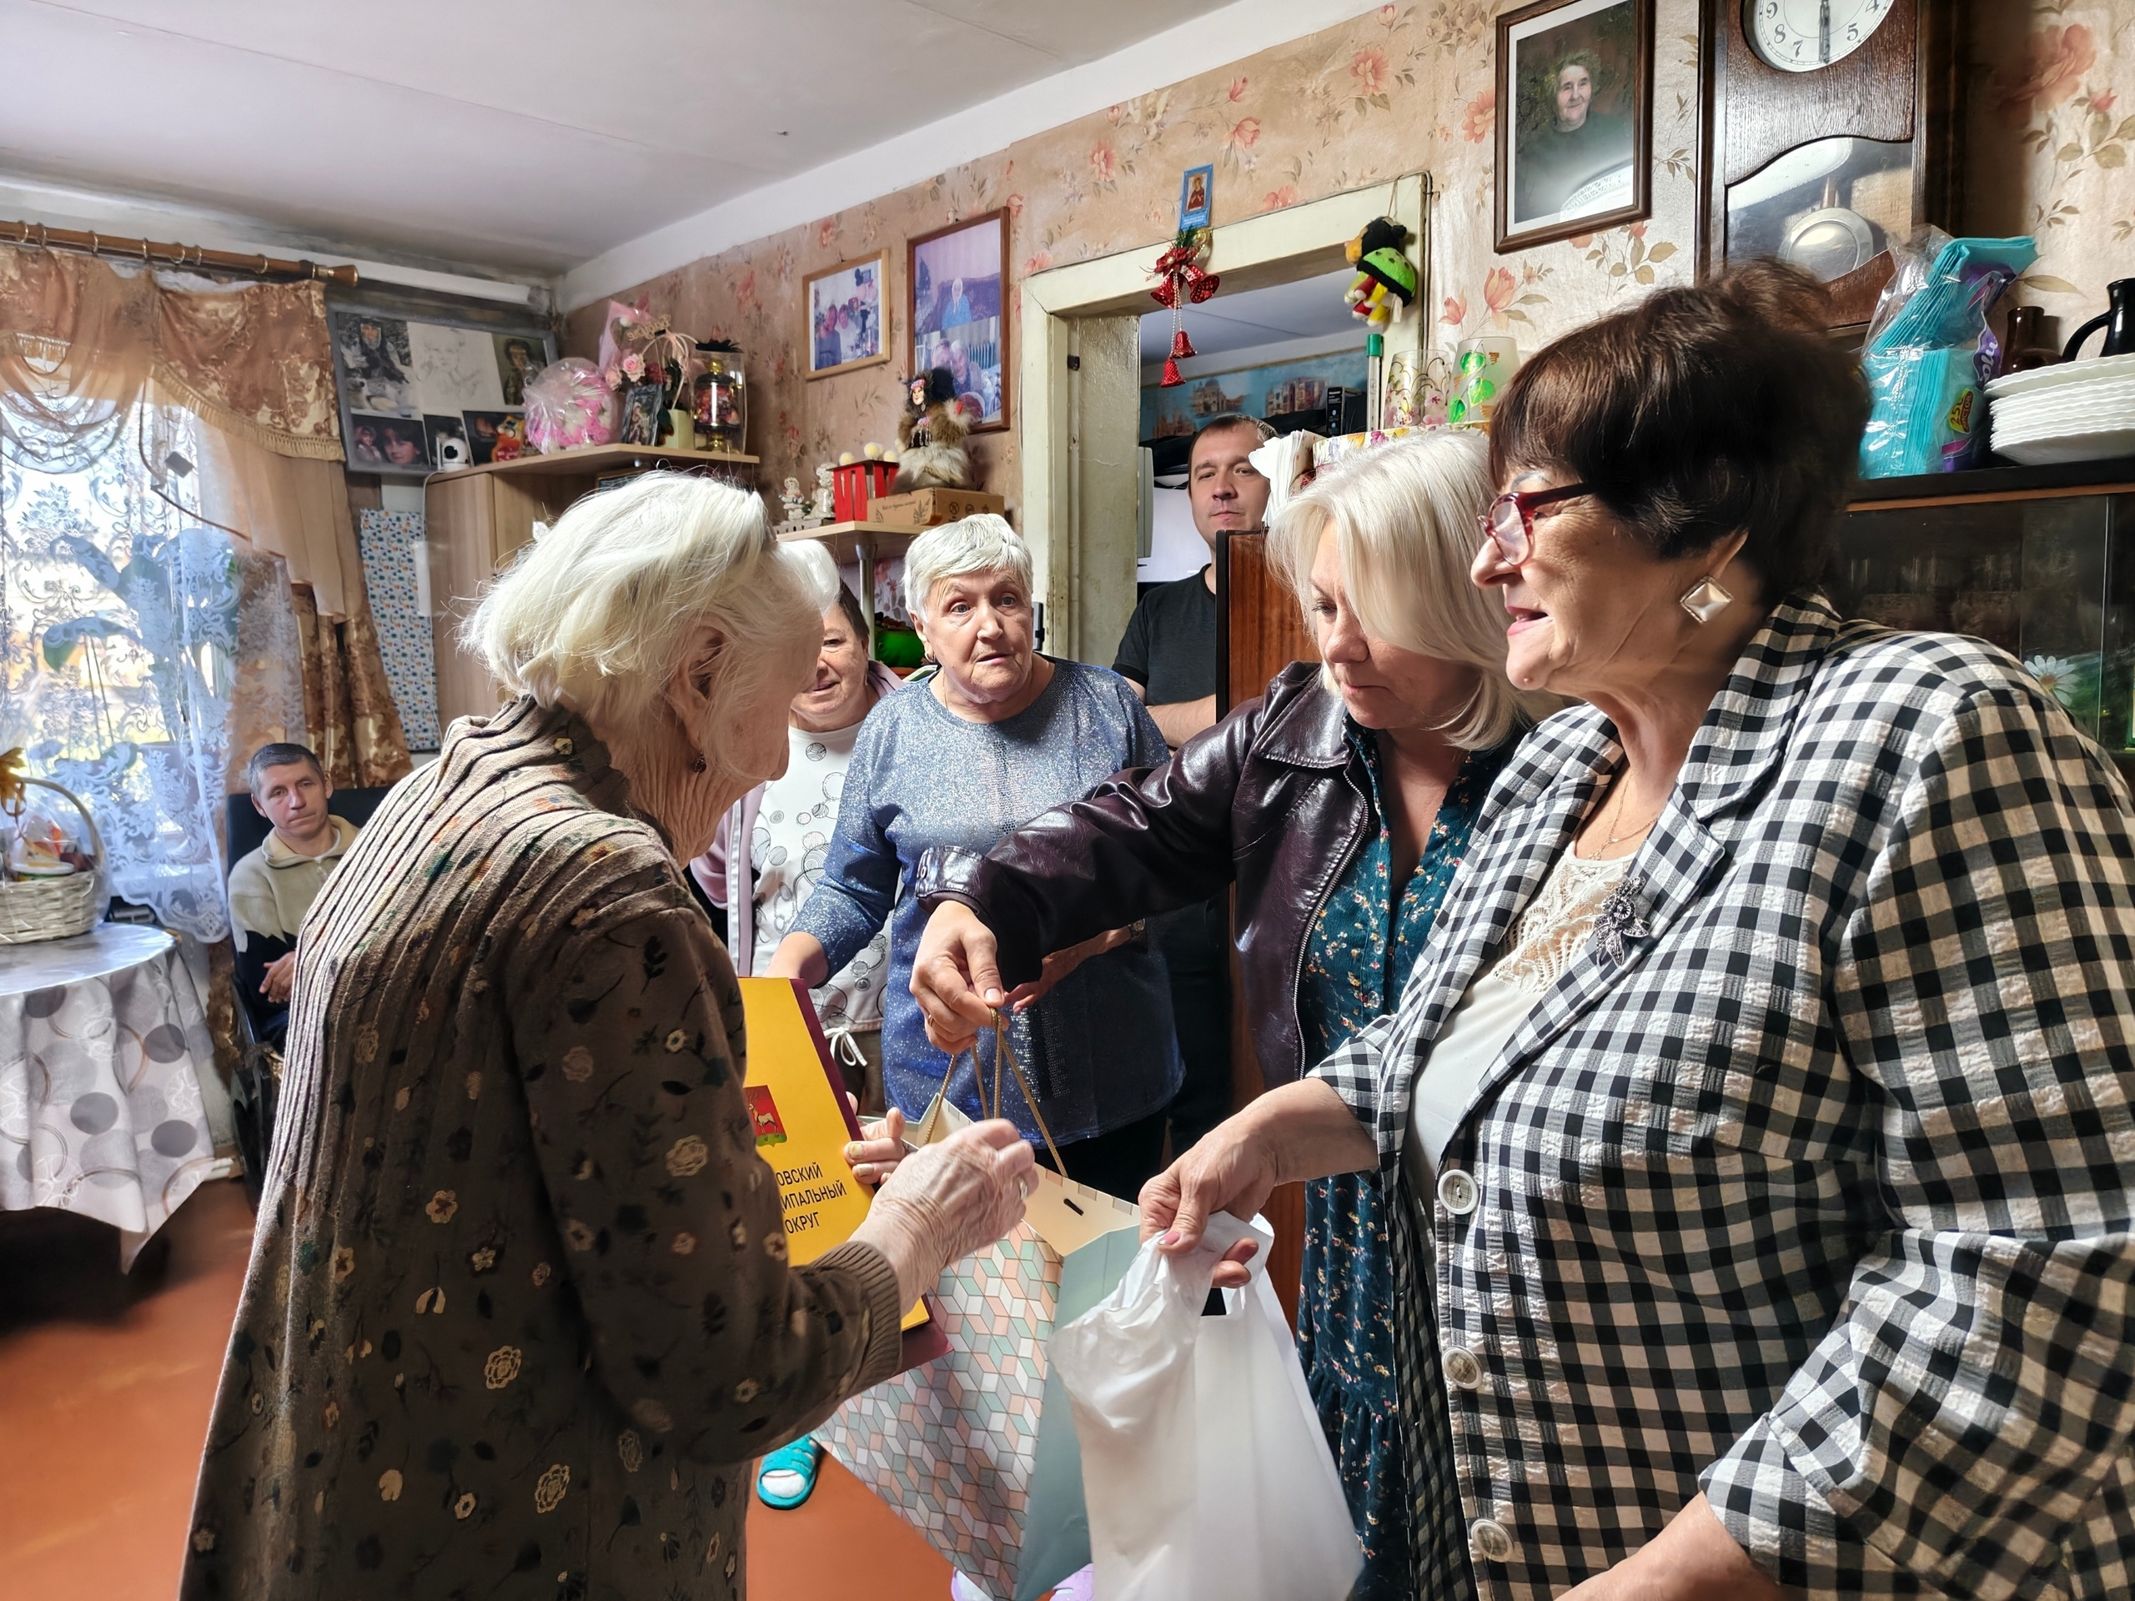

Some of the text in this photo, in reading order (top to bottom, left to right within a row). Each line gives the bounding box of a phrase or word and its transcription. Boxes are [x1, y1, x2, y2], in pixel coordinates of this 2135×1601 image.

[1766, 2, 1778, 19] 9
[1773, 24, 1786, 44] 8
[1846, 23, 1859, 41] 5
[1792, 40, 1803, 58] 7
[775, 1162, 823, 1186] ОВСКИЙ
[780, 1179, 847, 1213] ИПАЛЬНЫЙ
[784, 1211, 820, 1234] ОКРУГ
